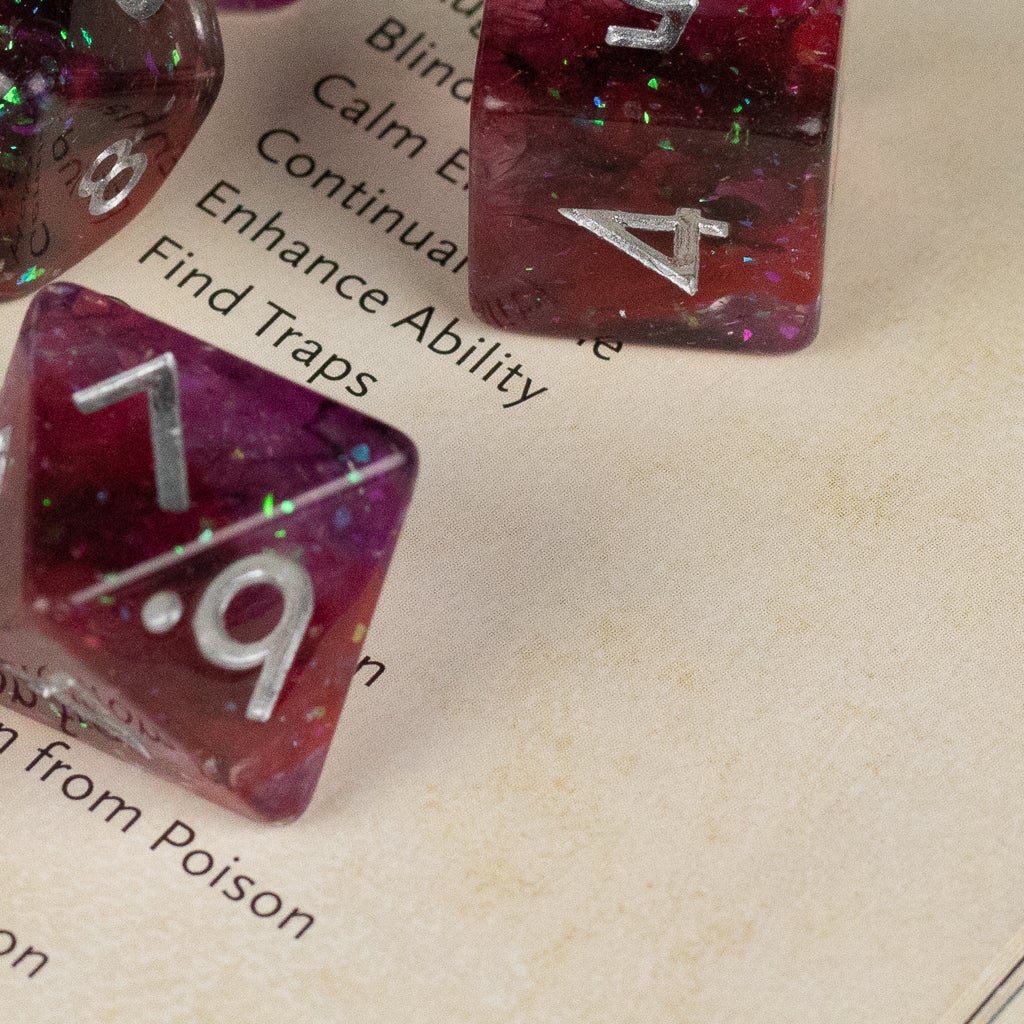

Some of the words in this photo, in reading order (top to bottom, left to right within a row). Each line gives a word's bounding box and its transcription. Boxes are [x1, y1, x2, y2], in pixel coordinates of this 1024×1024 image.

[78, 137, 149, 217] 8
[313, 72, 428, 161] Calm
[138, 234, 254, 316] Find
[254, 300, 379, 398] Traps
[195, 180, 389, 315] Enhance
[393, 305, 549, 409] Ability
[558, 207, 729, 297] 4
[72, 352, 190, 513] 7
[26, 739, 143, 834] from
[149, 819, 317, 943] Poison
